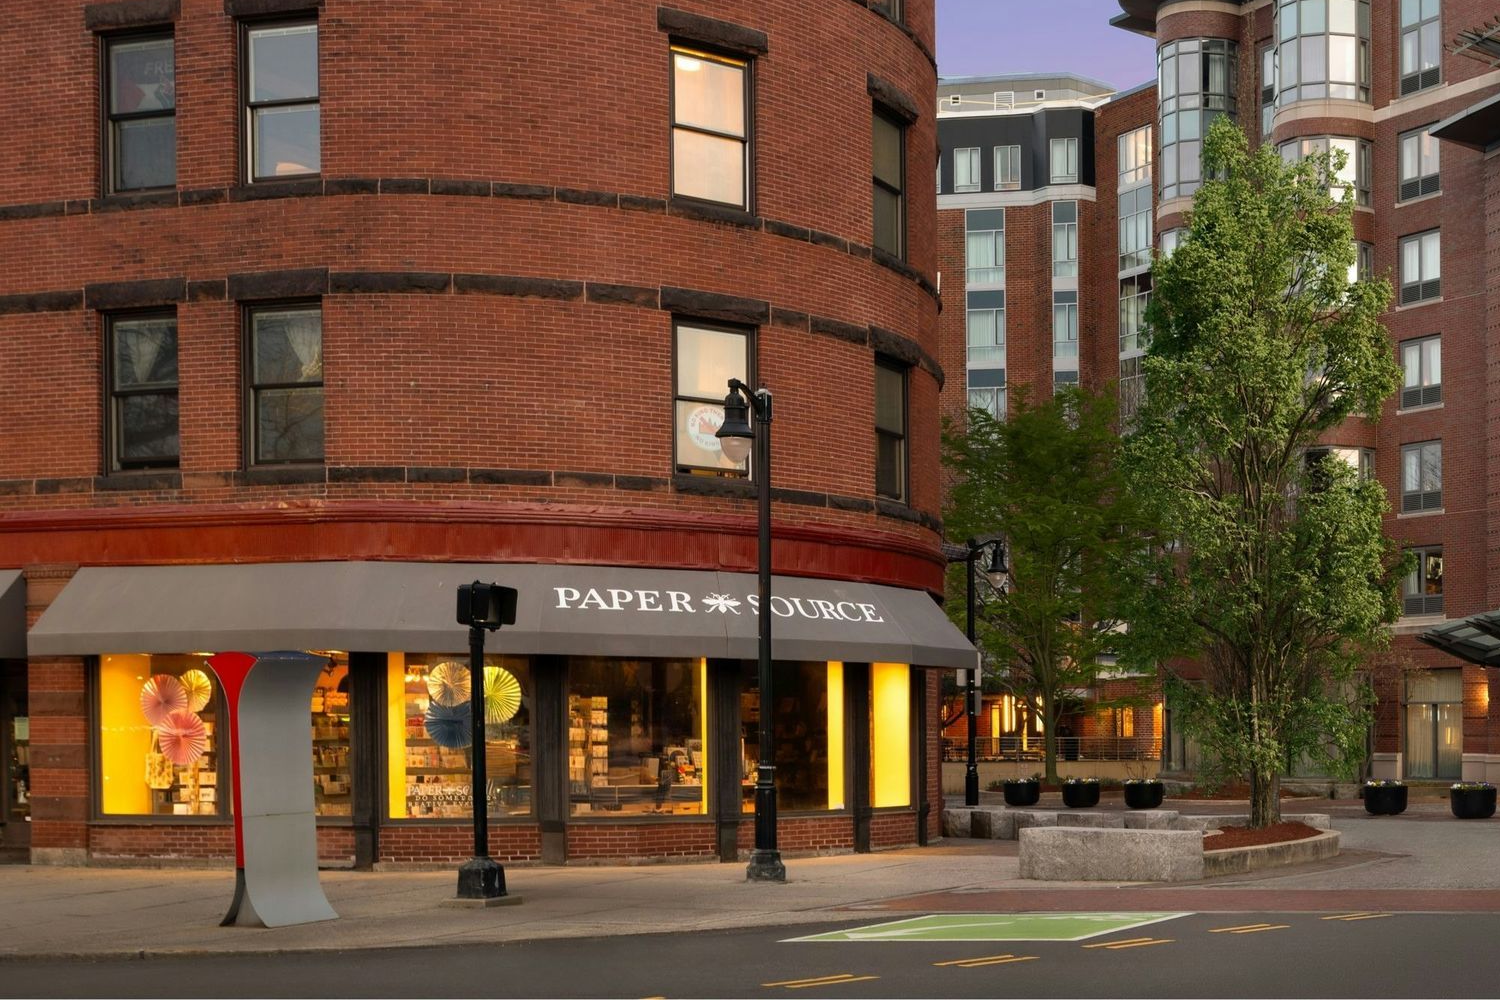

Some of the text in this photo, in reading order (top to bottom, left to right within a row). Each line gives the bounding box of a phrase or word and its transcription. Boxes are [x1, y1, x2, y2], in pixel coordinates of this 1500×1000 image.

[553, 587, 885, 623] PAPER SOURCE
[408, 785, 443, 796] PAPER
